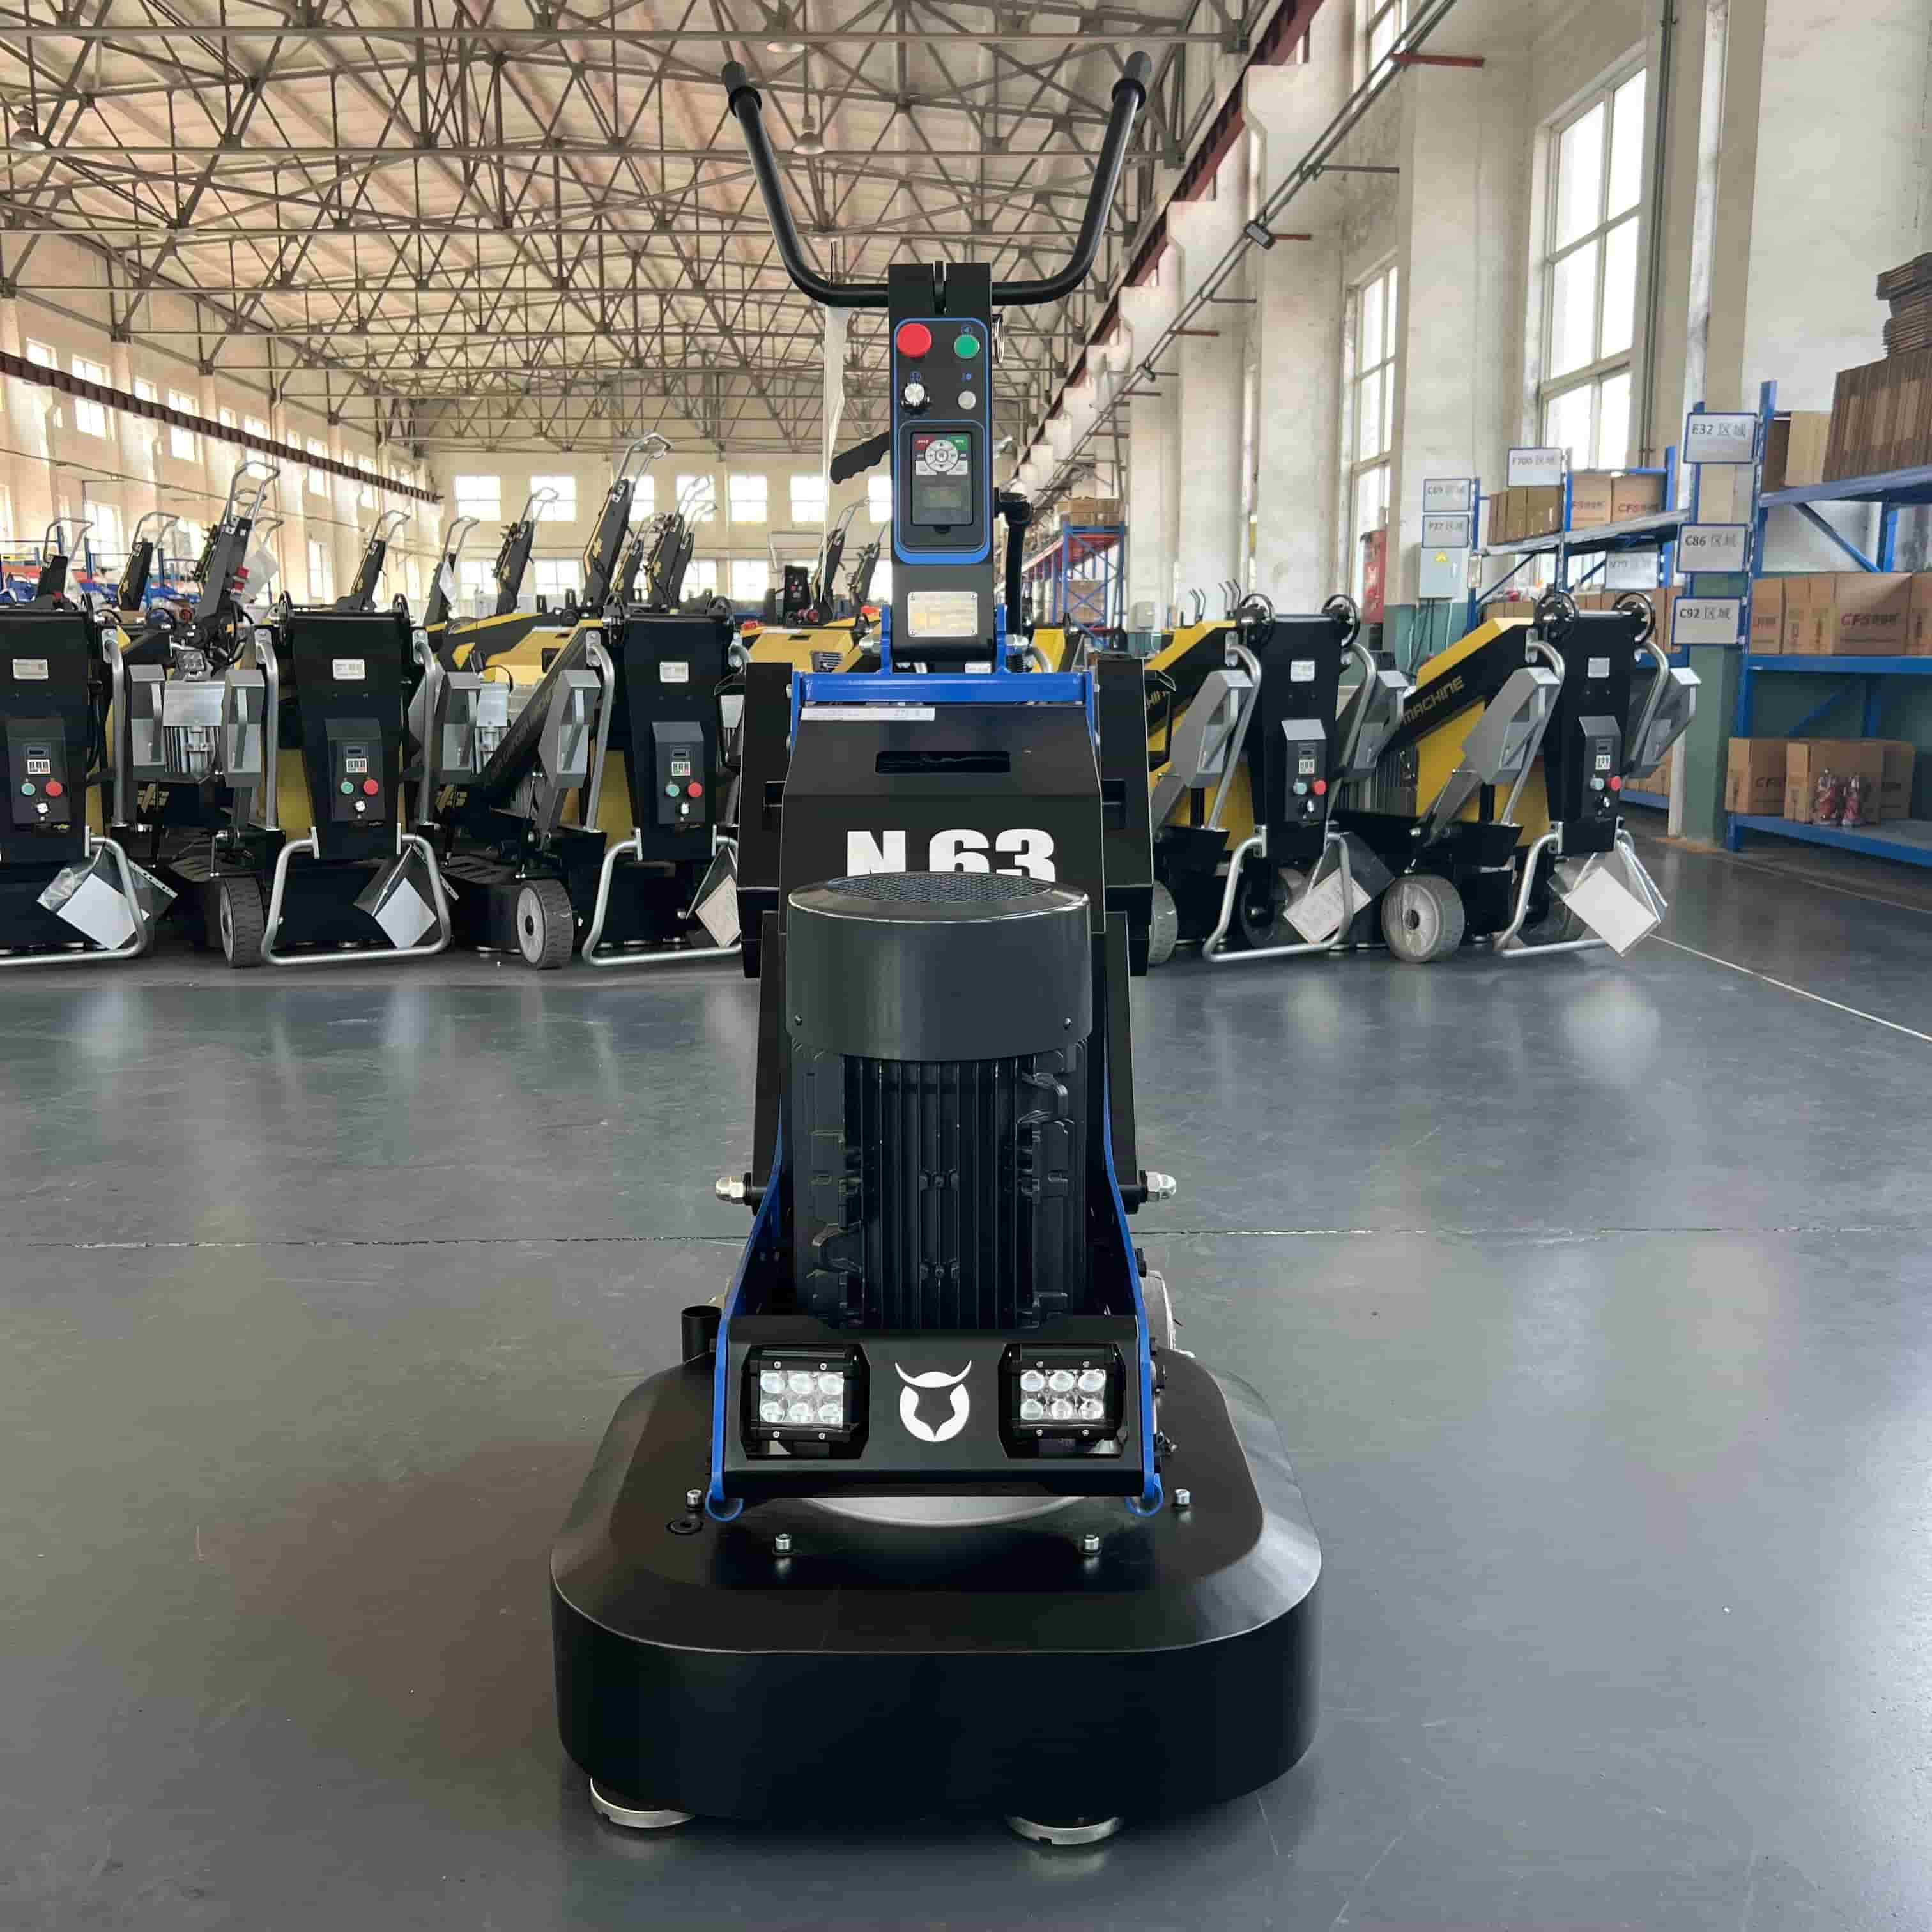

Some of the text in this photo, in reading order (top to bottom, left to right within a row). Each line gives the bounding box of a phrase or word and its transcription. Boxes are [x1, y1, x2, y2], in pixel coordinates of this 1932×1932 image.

[1692, 422, 1747, 438] E32 区域
[1685, 532, 1738, 548] C86 区域
[1679, 606, 1732, 621] C92 区域
[1400, 675, 1465, 726] MACHINE
[929, 829, 1056, 882] 63
